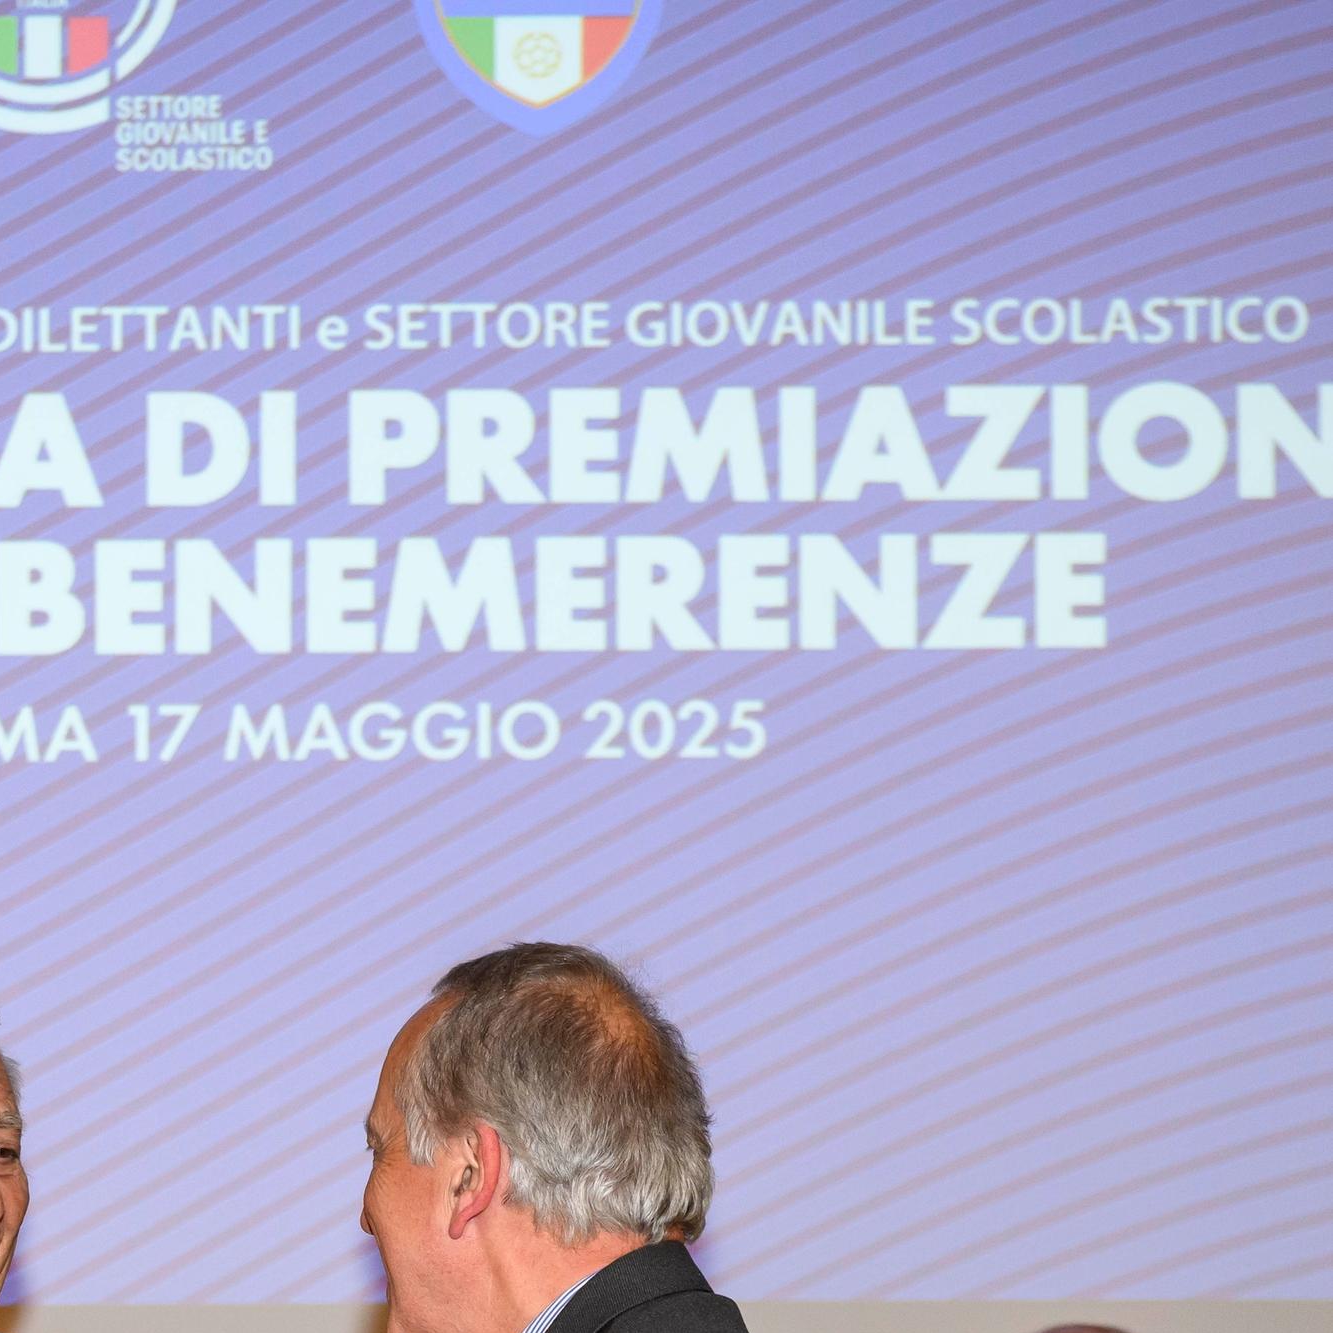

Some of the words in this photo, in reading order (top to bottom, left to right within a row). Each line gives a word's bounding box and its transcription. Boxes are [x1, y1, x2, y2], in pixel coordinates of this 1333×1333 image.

[116, 94, 223, 119] SETTORE
[115, 120, 246, 145] GIOVANILE
[254, 118, 269, 144] E
[115, 145, 273, 172] SCOLASTICO
[316, 316, 348, 350] e
[364, 302, 610, 350] SETTORE
[626, 299, 935, 347] GIOVANILE
[952, 297, 1307, 344] SCOLASTICO
[145, 390, 297, 507] DI
[348, 381, 1333, 505] PREMIAZION
[127, 703, 201, 762] 17
[223, 700, 561, 762] MAGGIO
[583, 698, 767, 760] 2025
